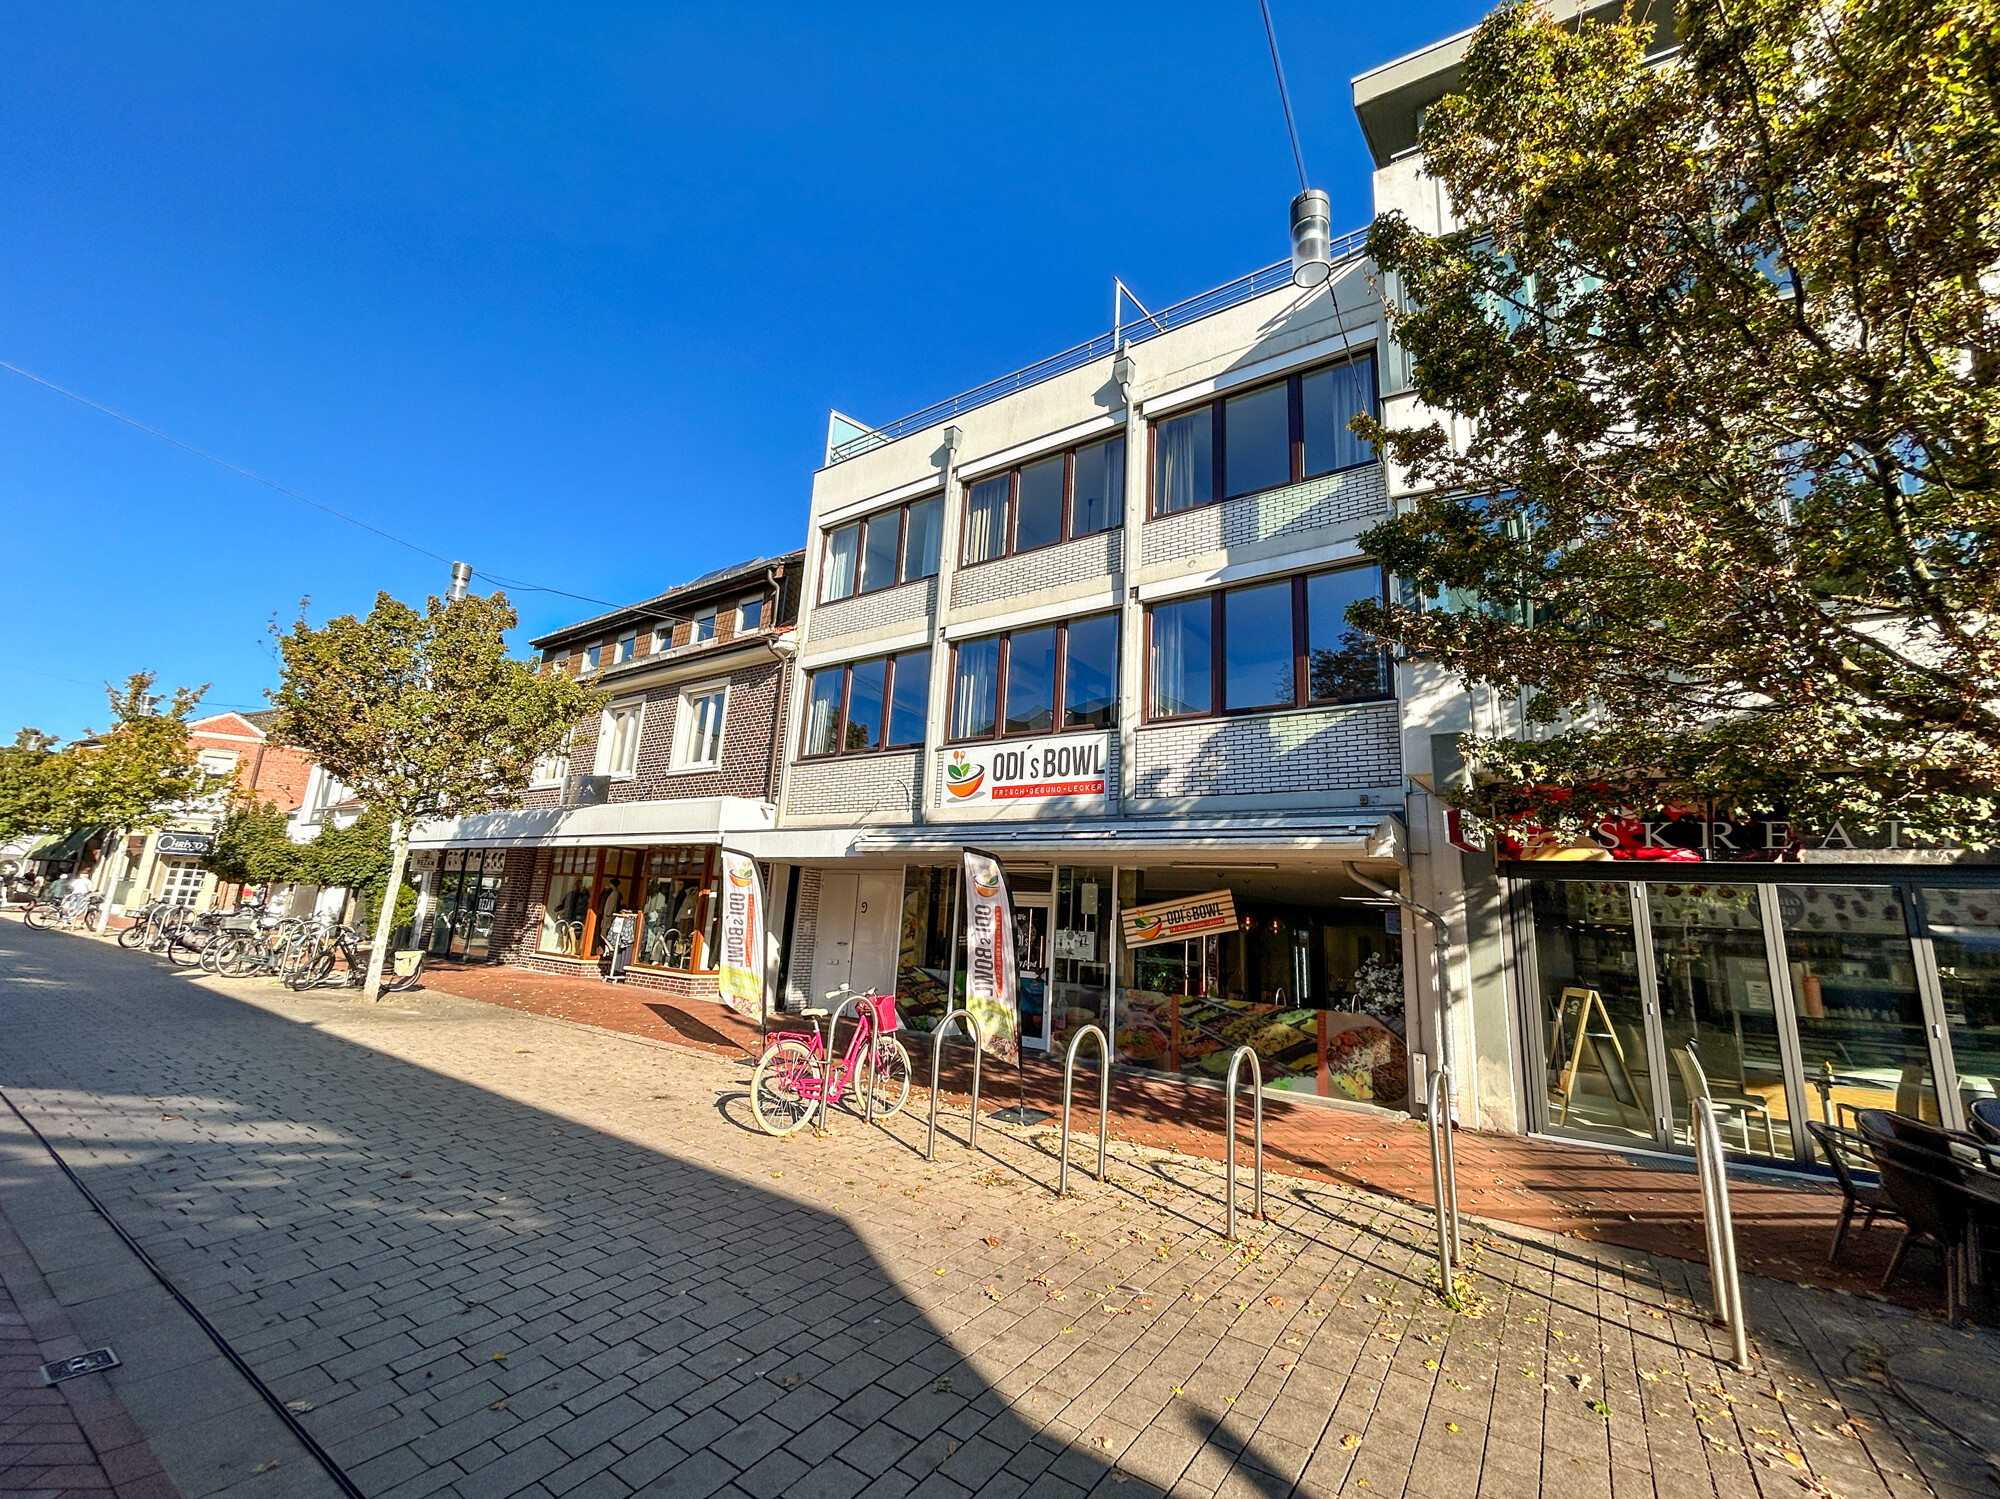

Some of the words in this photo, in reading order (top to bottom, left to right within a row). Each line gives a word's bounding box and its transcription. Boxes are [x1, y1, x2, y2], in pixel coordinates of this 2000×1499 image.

[1043, 744, 1105, 778] BOWL
[994, 788, 1025, 797] FRISCH
[1029, 786, 1062, 795] GESUND
[1067, 783, 1103, 793] LECKER
[1191, 902, 1224, 920] BOWL
